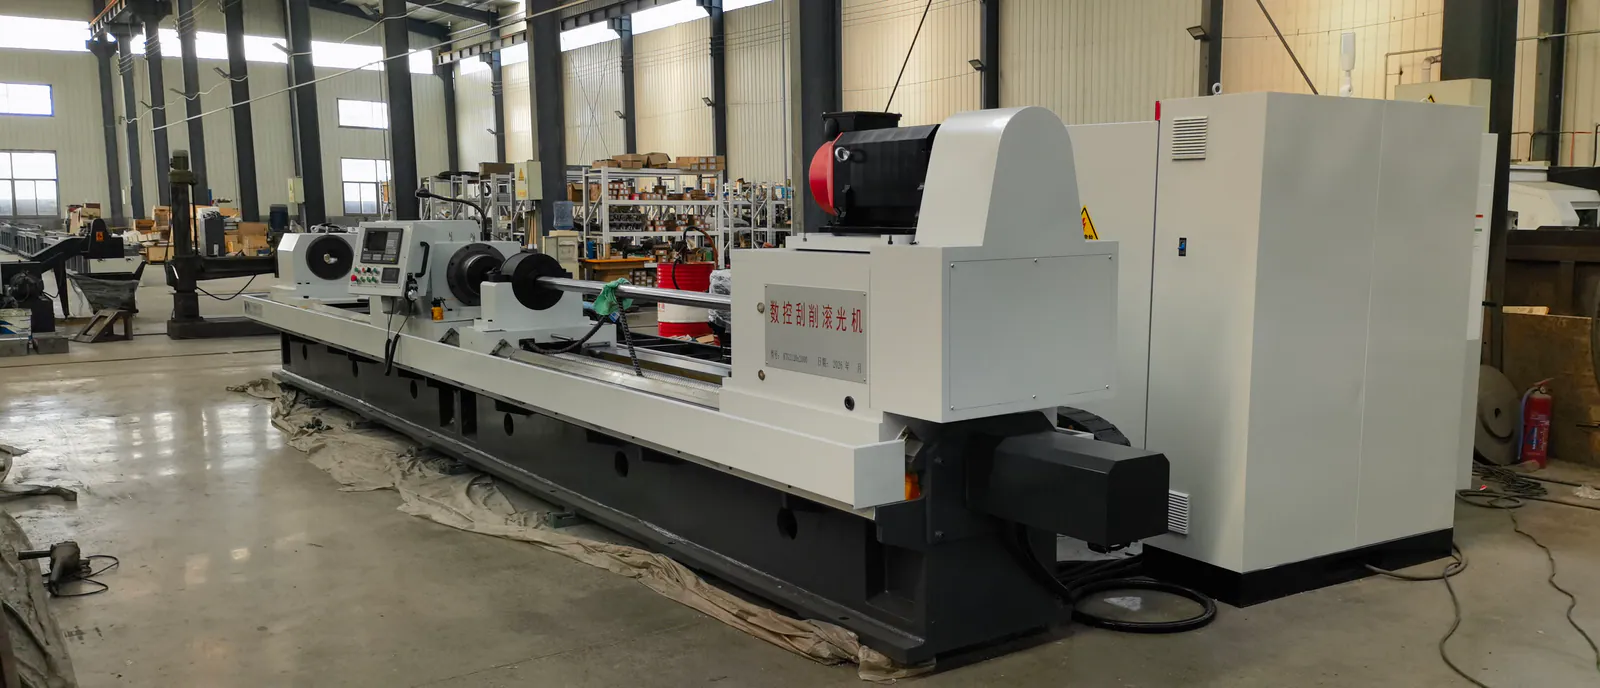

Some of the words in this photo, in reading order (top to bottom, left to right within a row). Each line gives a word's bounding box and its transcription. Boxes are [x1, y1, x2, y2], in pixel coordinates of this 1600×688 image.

[769, 300, 863, 334] 数控刮削滚光机
